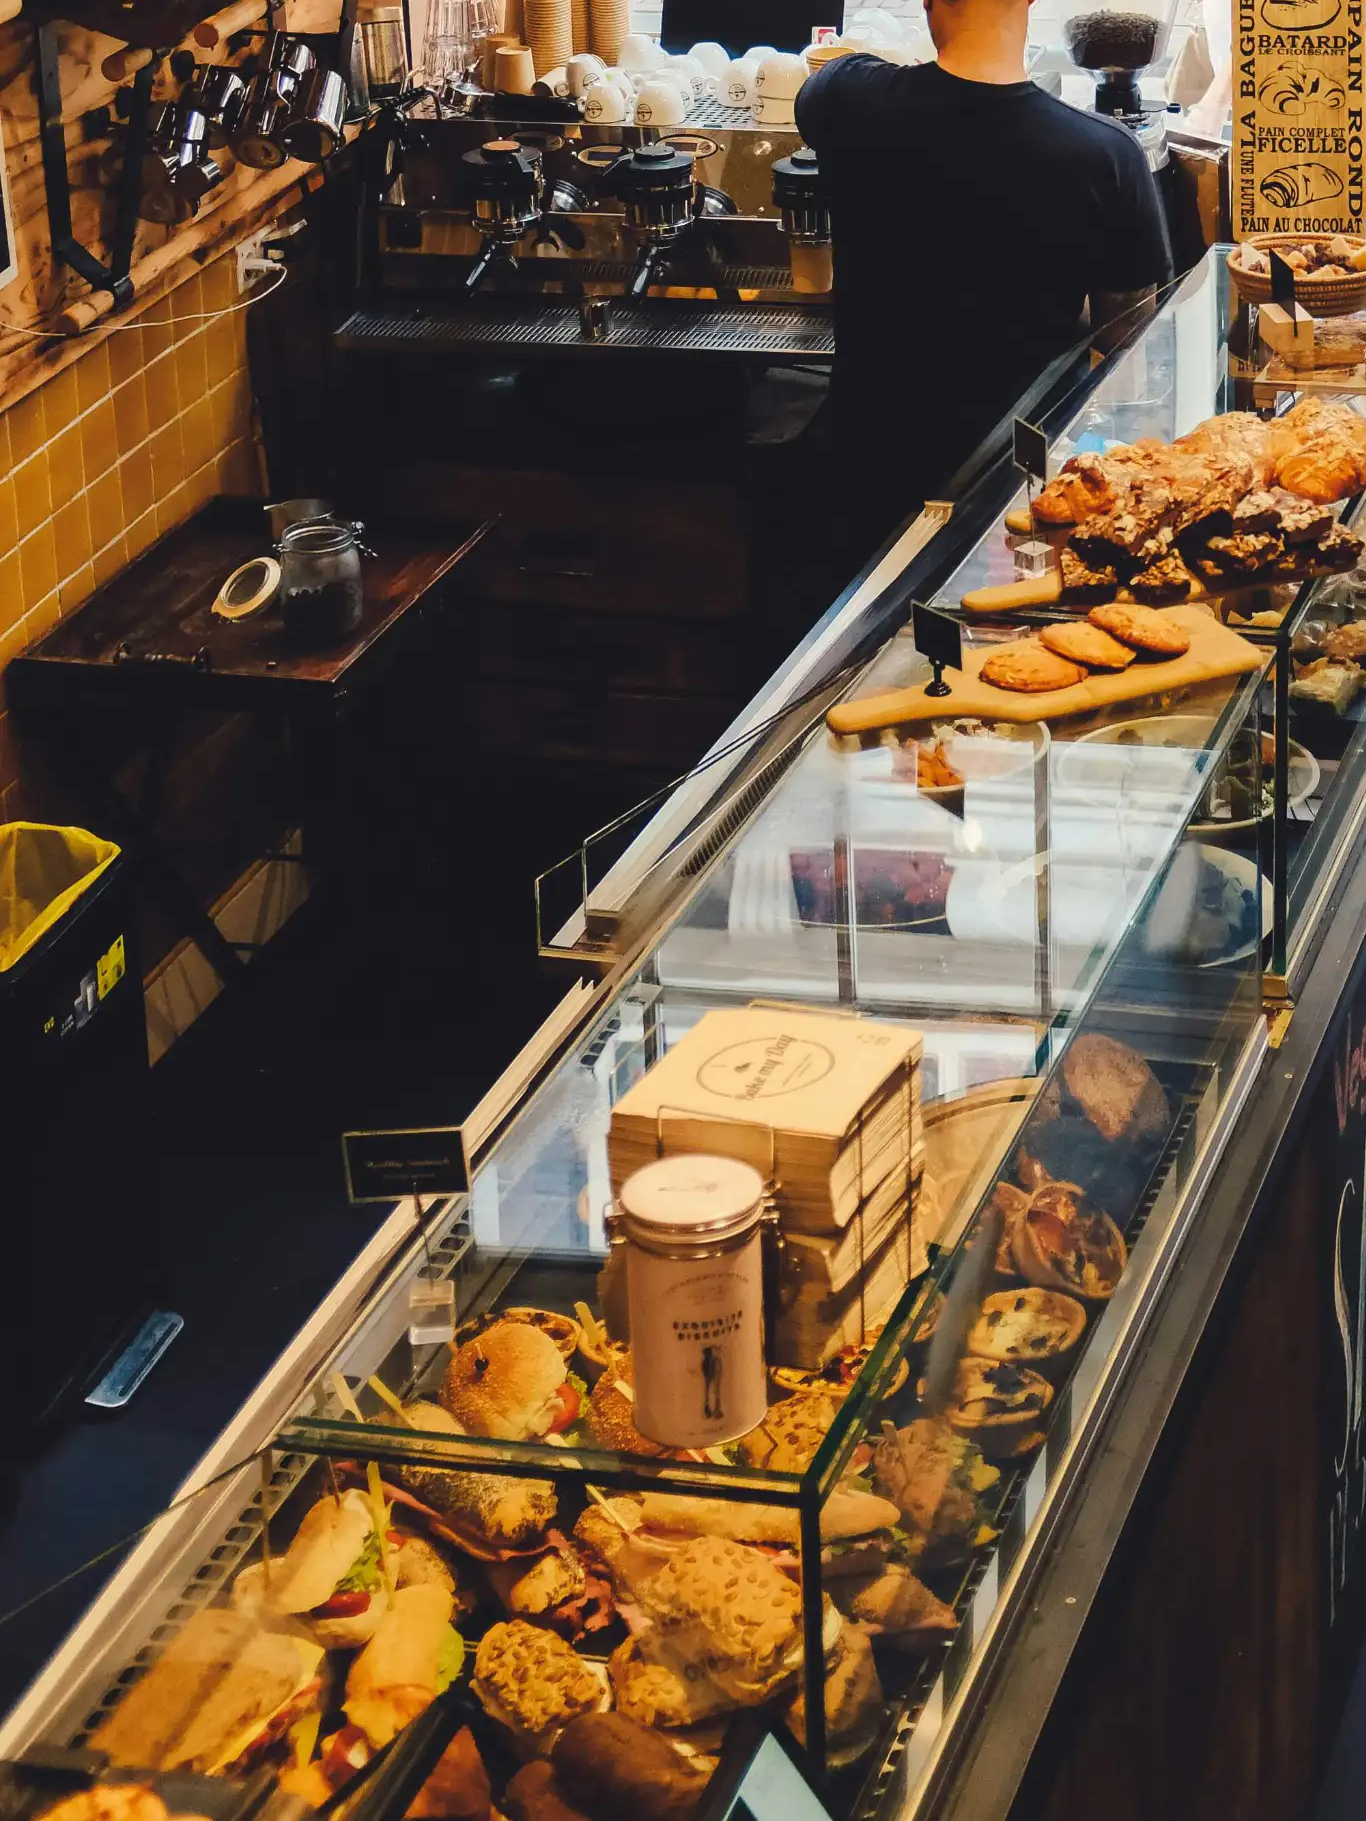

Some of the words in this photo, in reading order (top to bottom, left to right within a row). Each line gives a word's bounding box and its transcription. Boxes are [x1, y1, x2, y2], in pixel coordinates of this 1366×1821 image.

[1258, 34, 1348, 49] BATARD
[1258, 48, 1274, 56] LE
[1277, 48, 1347, 56] CROISSANT
[1347, 4, 1362, 94] PAIN
[1240, 109, 1256, 149] LA
[1258, 126, 1285, 137] PAIN
[1289, 127, 1346, 138] COMPLET
[1257, 137, 1347, 154] FICELLE
[1240, 150, 1255, 175] UNE
[1348, 107, 1363, 217] ROND
[1240, 179, 1255, 218] FLUTE
[1240, 216, 1270, 233] PAIN
[1274, 217, 1290, 233] AU
[1294, 217, 1363, 234] CHOCOLAT
[764, 1033, 799, 1058] Day
[758, 1057, 785, 1081] my
[677, 1321, 741, 1342] BISCUITS
